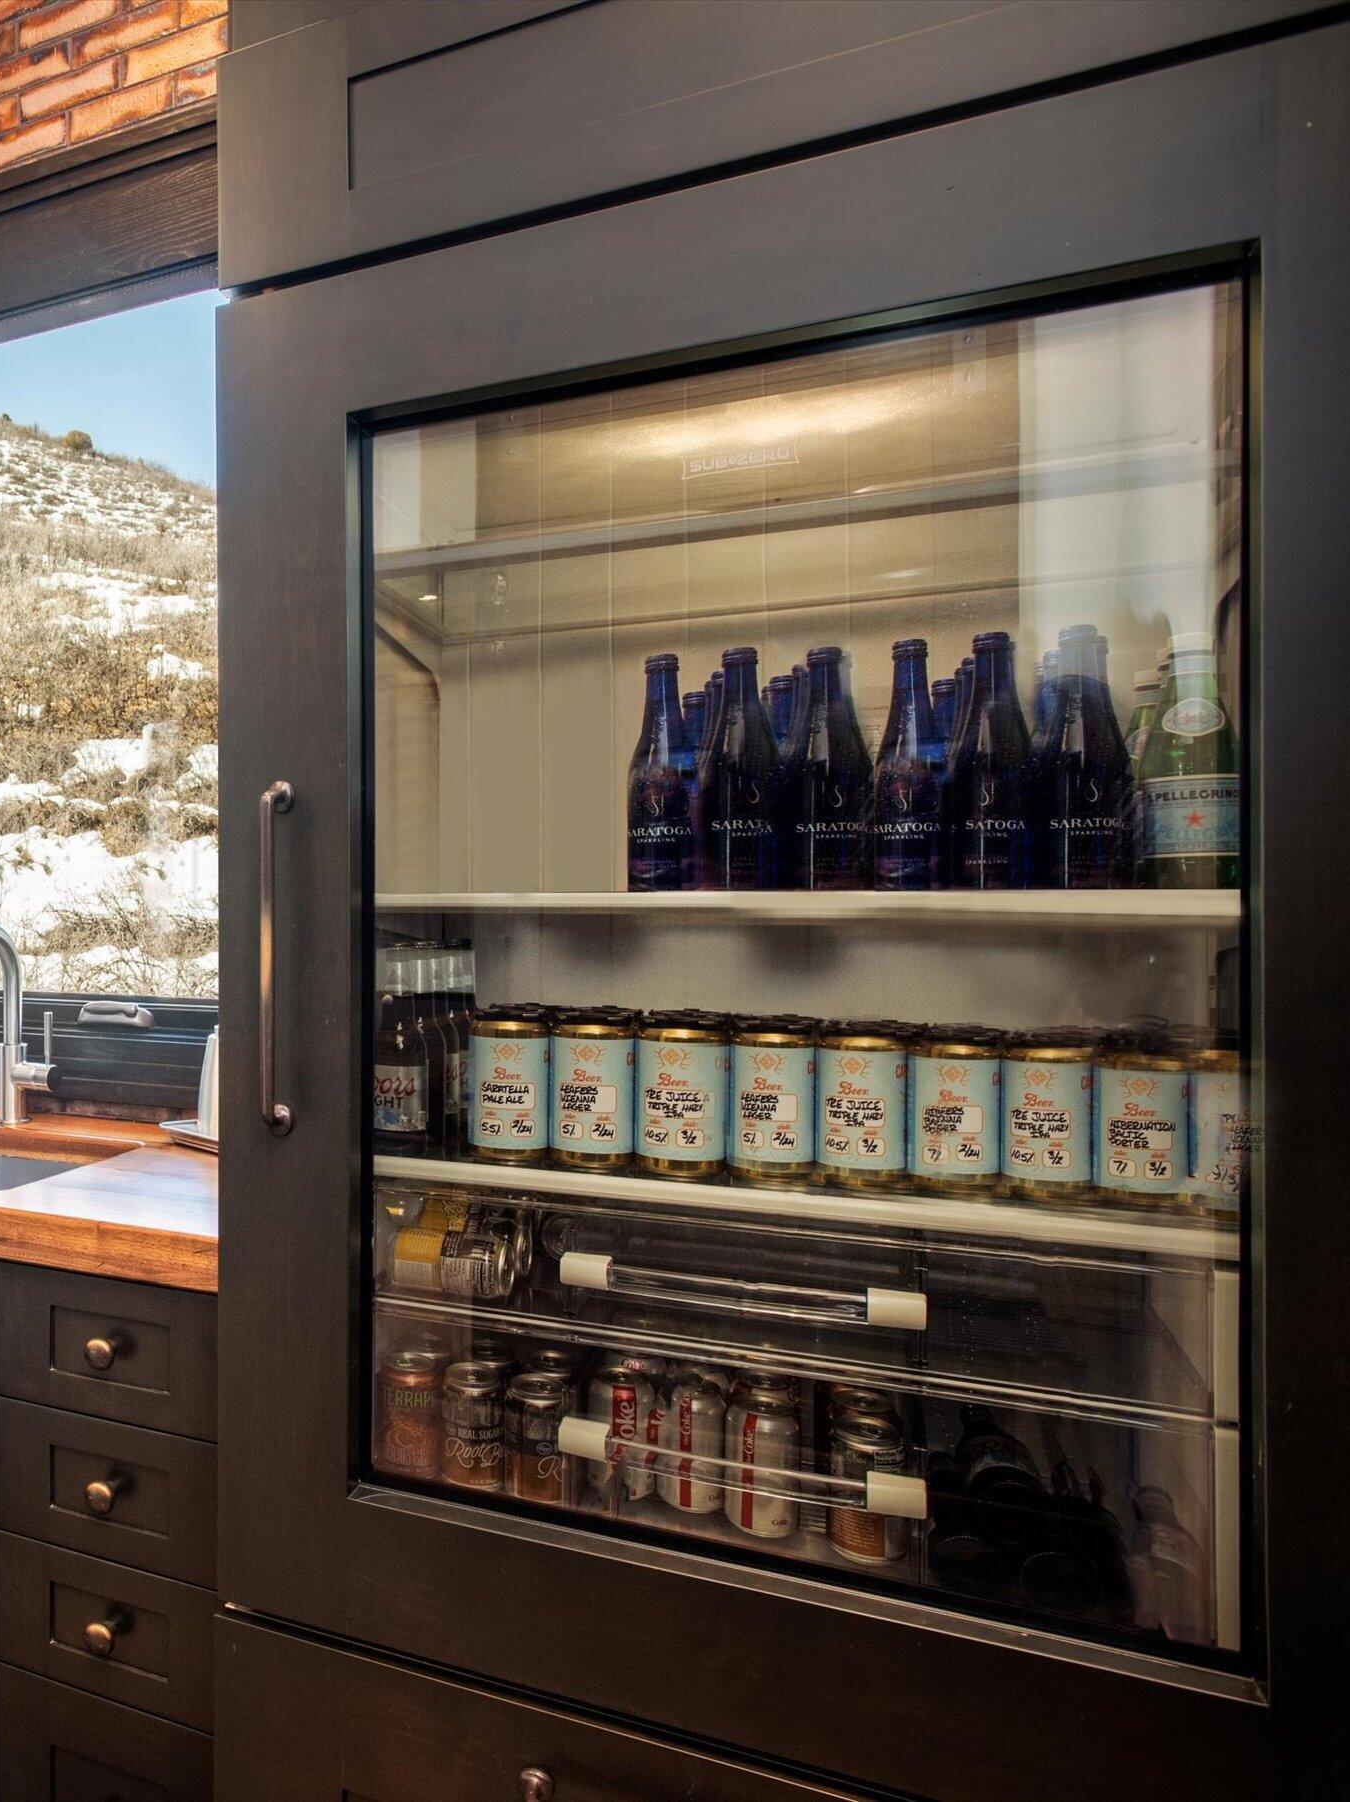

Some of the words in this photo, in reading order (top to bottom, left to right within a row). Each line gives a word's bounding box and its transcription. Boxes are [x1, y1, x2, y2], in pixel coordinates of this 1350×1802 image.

[627, 826, 692, 837] SARATOGA
[873, 822, 941, 834] SARATOGA
[482, 1094, 504, 1105] PALE
[506, 1095, 525, 1105] ALE
[560, 1094, 596, 1104] VIENNA
[665, 1091, 701, 1102] JUICE
[562, 1103, 592, 1112] LAGER
[648, 1101, 678, 1111] TRIPLE
[741, 1103, 777, 1112] VIENNA
[846, 1100, 882, 1111] JUICE
[664, 1110, 684, 1118] IPA
[743, 1112, 772, 1120] LAGER
[828, 1110, 860, 1120] TRIPLE
[1031, 1111, 1068, 1123] JUICE
[512, 1119, 533, 1135] 2/24
[844, 1119, 865, 1127] IPA
[1014, 1121, 1045, 1131] TRIPLE
[1109, 1120, 1177, 1132] HIBERNATION
[592, 1123, 615, 1138] 2/24
[1030, 1130, 1051, 1139] IPA
[1109, 1128, 1148, 1140] BALTIC
[680, 1130, 697, 1144] 3/2
[772, 1132, 795, 1147] 2/24
[861, 1138, 878, 1153] 3/2
[1108, 1137, 1150, 1149] PORTER
[958, 1144, 980, 1159] 2/24
[1047, 1150, 1064, 1165] 3/2
[1149, 1161, 1168, 1177] 3/2
[615, 1401, 636, 1440] oke
